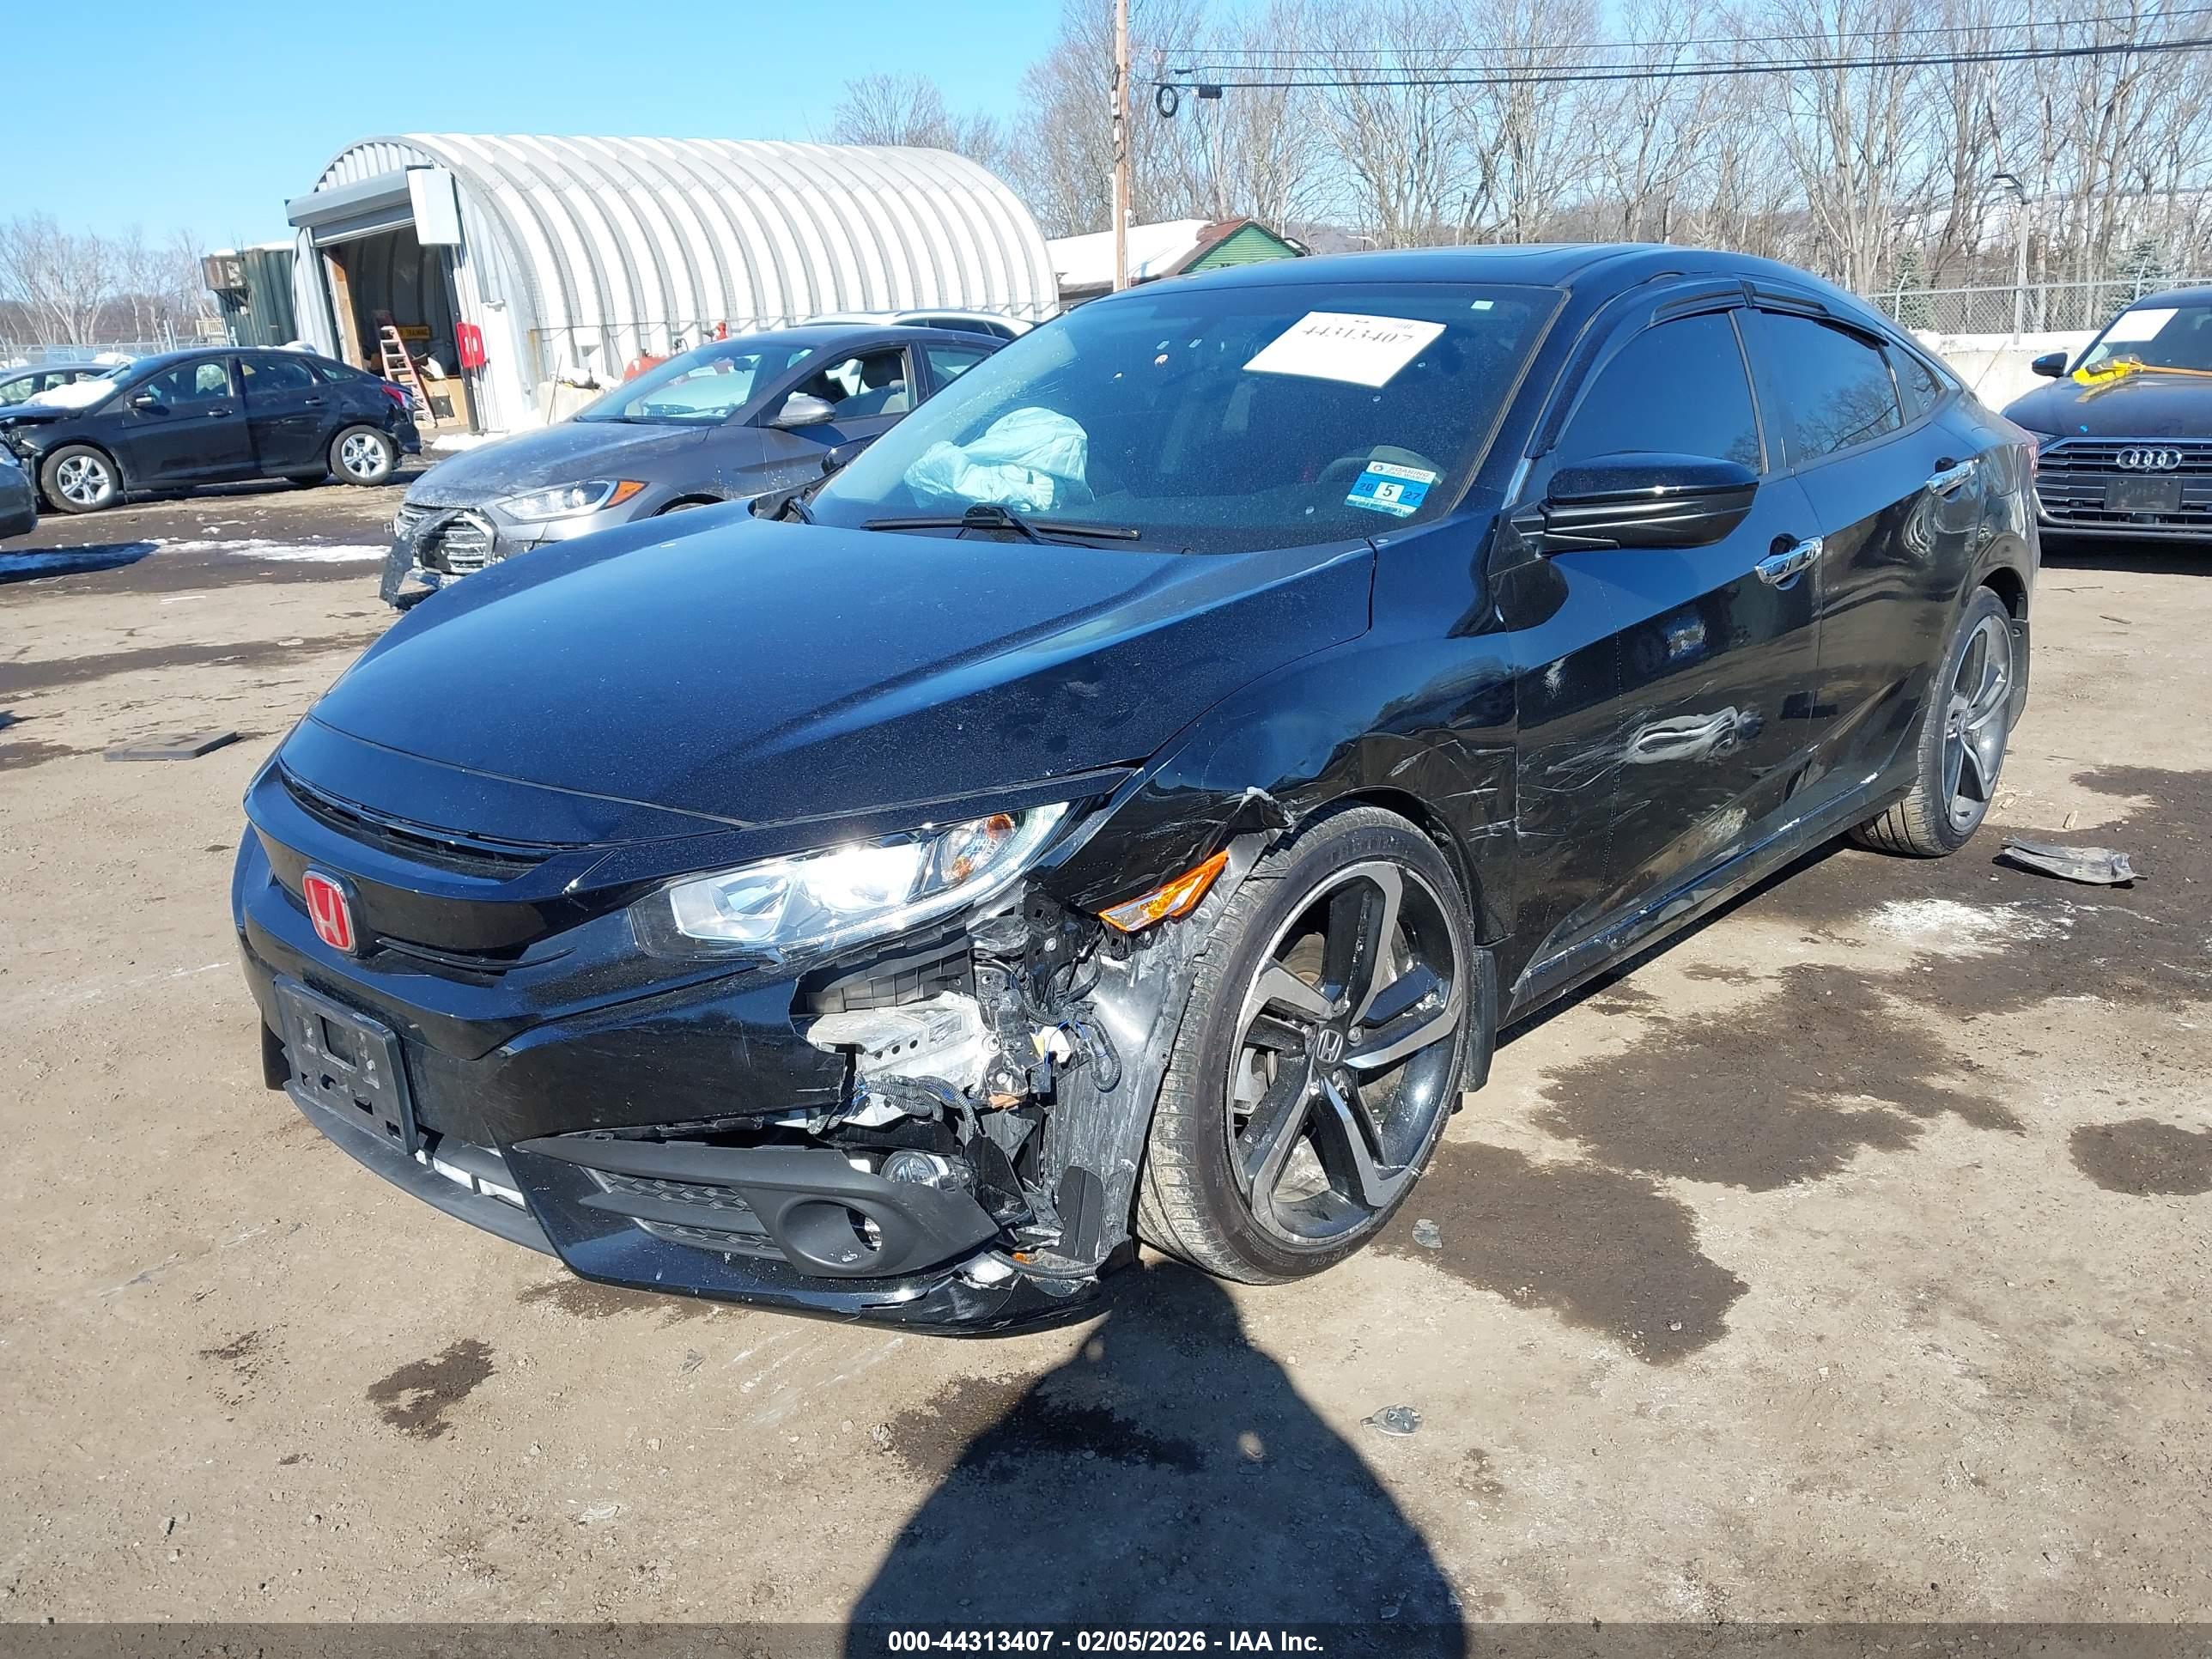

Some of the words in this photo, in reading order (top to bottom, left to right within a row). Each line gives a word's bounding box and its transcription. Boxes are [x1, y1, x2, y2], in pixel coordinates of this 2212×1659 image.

[1302, 325, 1416, 344] 44313407
[1359, 483, 1374, 492] 20
[1382, 484, 1395, 497] 5
[1403, 491, 1423, 501] 27
